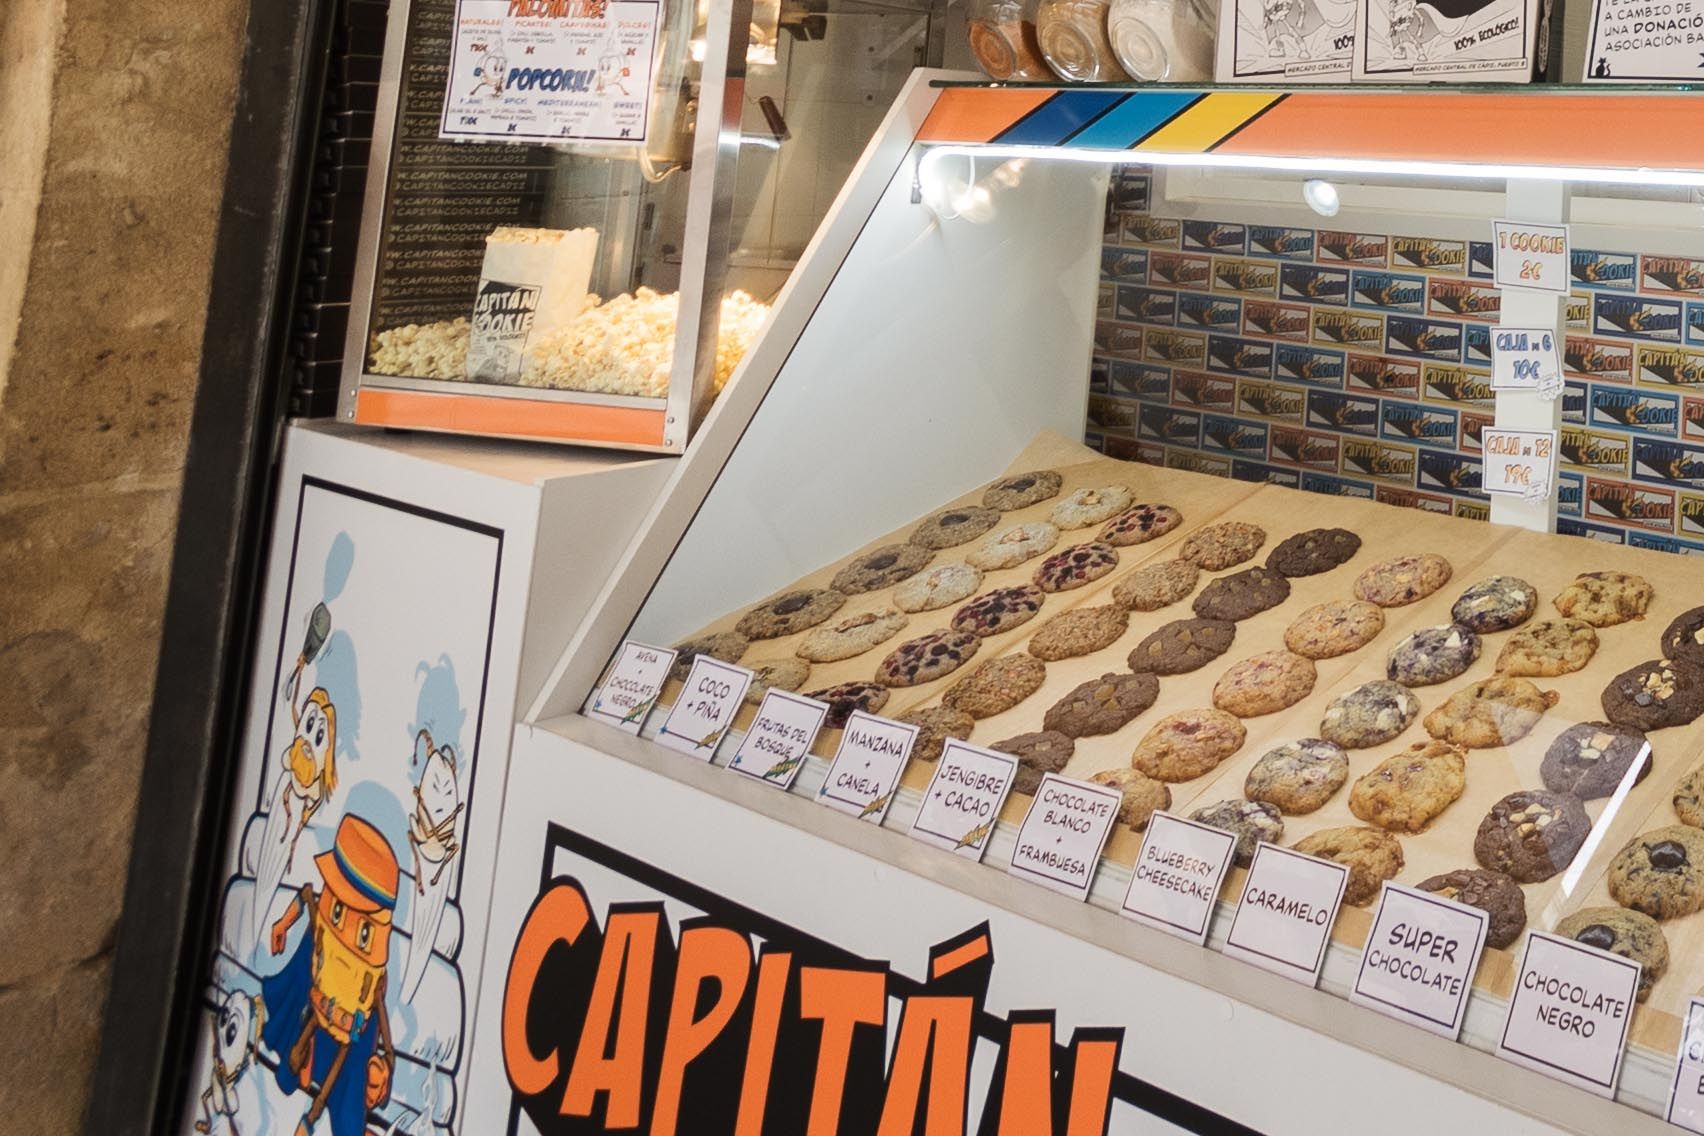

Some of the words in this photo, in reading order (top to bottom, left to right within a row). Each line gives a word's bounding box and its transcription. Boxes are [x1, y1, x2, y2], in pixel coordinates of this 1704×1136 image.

[1617, 4, 1669, 20] CAMBIO
[1676, 3, 1692, 15] DE
[1604, 24, 1629, 37] UNA
[1604, 33, 1683, 52] ASOCIACIÓN
[506, 67, 596, 92] POPCORN!
[1510, 231, 1564, 254] COOKIE
[1520, 260, 1542, 280] 2€
[1496, 333, 1528, 352] CAJA
[1513, 360, 1540, 380] 10€
[1487, 435, 1520, 456] CAJA
[635, 649, 658, 664] AVENA
[609, 675, 654, 697] CHOCOLATE
[698, 676, 731, 699] COCO
[694, 698, 721, 722] PIÑA
[758, 716, 790, 739] FRUTAS
[790, 726, 807, 744] DEL
[755, 736, 793, 761] BOSQUE
[848, 729, 904, 758] MANZANA
[836, 772, 880, 798] CANELA
[940, 765, 1004, 795] JENGIBRE
[944, 791, 991, 818] CACAO
[1043, 788, 1110, 817] CHOCOLATE
[1043, 810, 1092, 835] BLANCO
[1018, 844, 1086, 878] FRAMBUESA
[1146, 845, 1216, 879] BLUEBERRY
[1136, 865, 1214, 903] CHEESECAKE
[1246, 887, 1328, 927] CARAMELO
[1388, 922, 1459, 966] SUPER
[1368, 949, 1462, 997] CHOCOLATE
[501, 874, 1126, 1136] CAPITÁN
[1522, 970, 1626, 1020] CHOCOLATE
[1535, 1004, 1596, 1040] NEGRO
